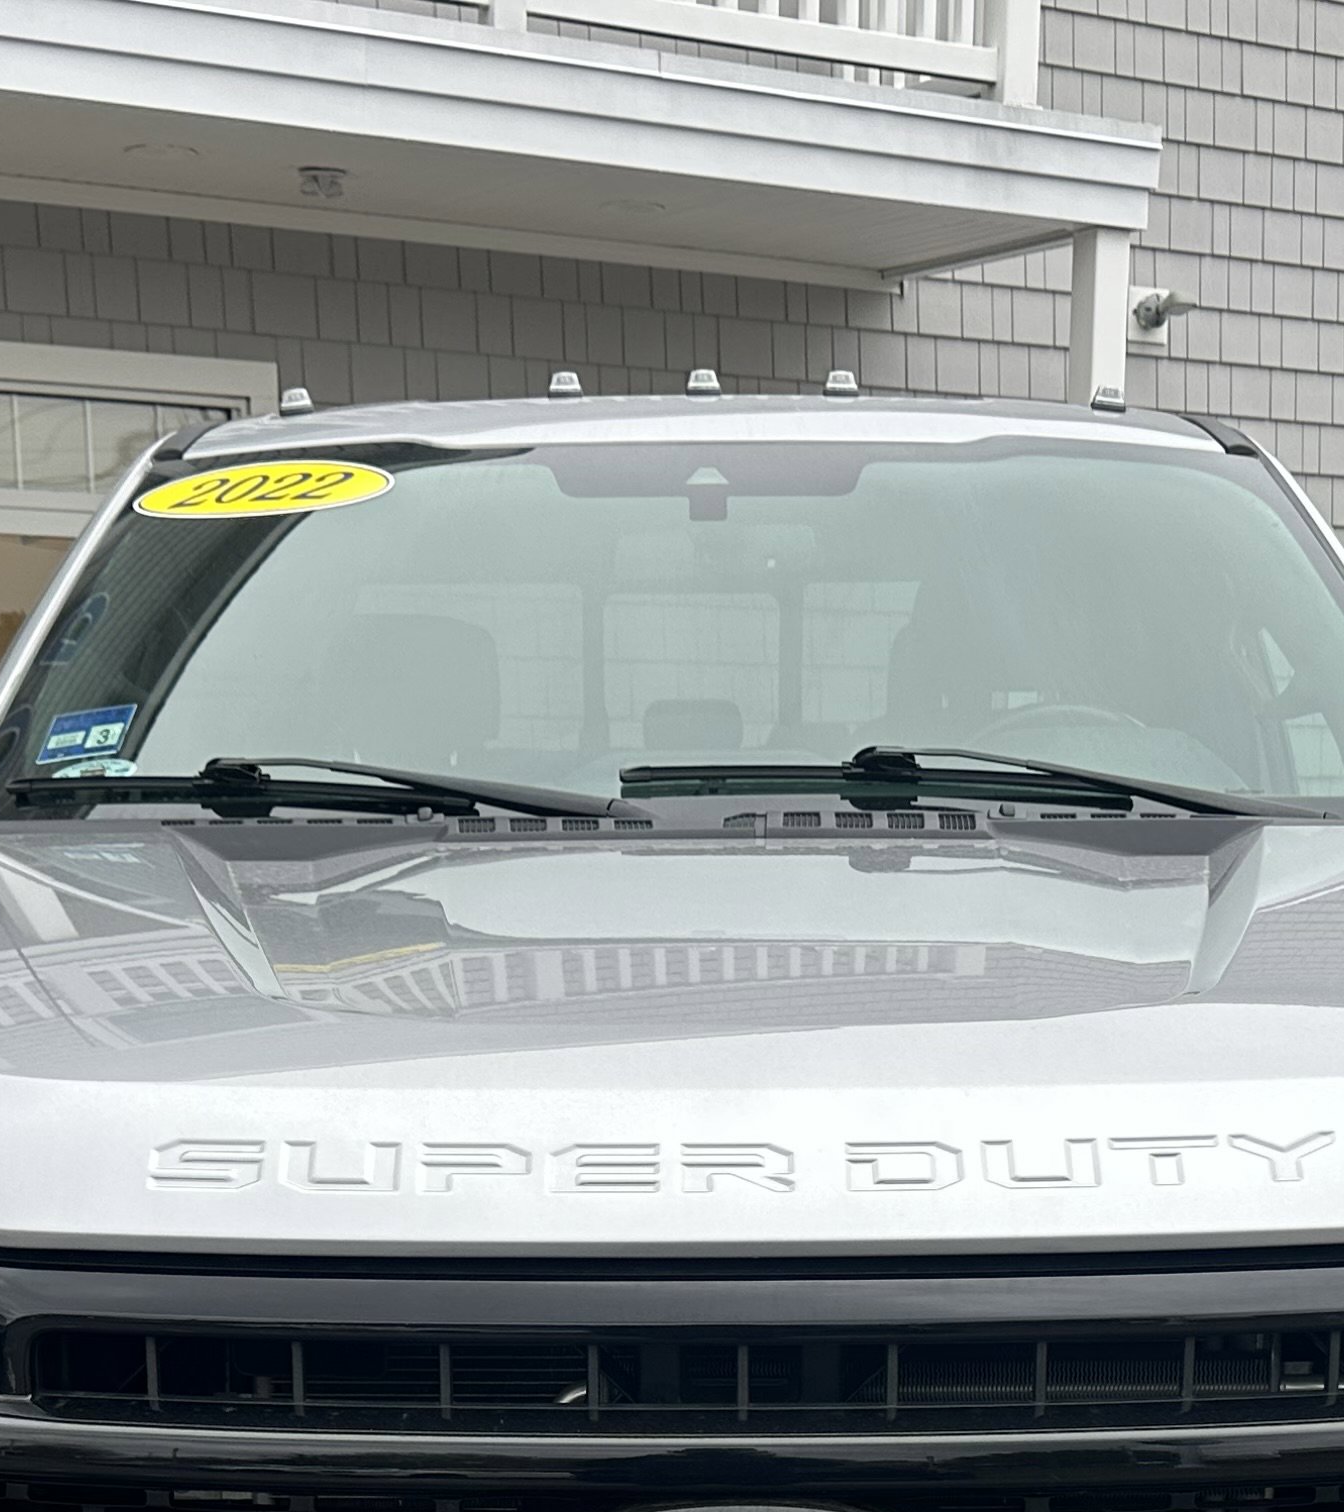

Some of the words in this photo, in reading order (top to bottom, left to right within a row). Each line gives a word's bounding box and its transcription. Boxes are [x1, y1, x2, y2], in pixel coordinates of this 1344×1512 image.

[167, 471, 355, 510] 2022
[146, 1138, 798, 1194] SUPER
[845, 1130, 1336, 1193] DUTY
